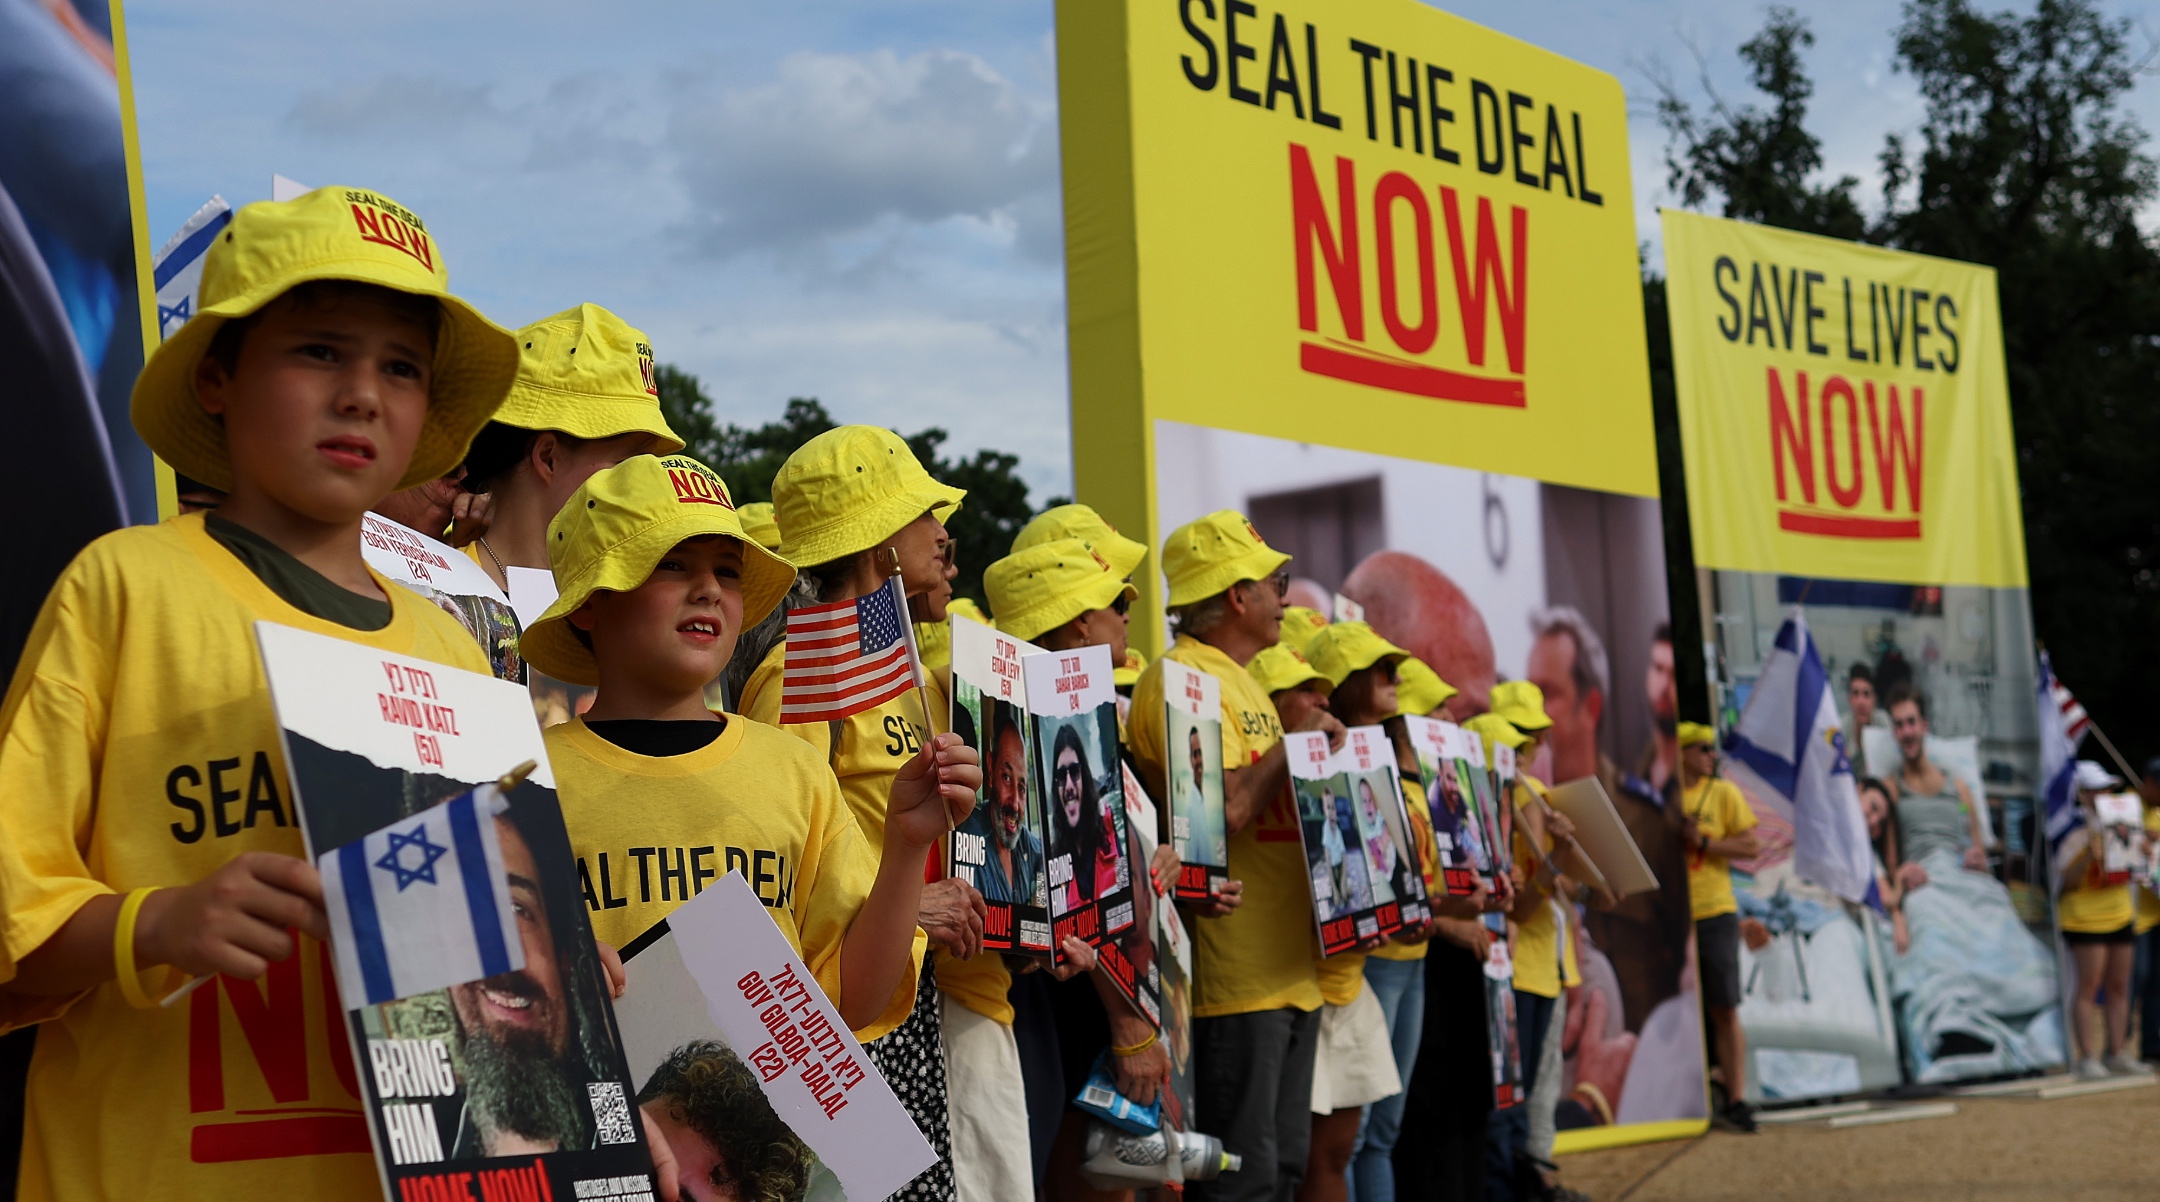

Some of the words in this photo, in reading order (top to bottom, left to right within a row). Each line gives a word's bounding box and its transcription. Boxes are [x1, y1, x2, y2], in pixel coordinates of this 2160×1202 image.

[1178, 0, 1342, 132] SEAL
[1349, 38, 1461, 166] THE
[1470, 78, 1605, 207] DEAL
[345, 190, 380, 208] SEAL
[377, 197, 401, 218] THE
[350, 203, 434, 273] NOW
[1289, 141, 1529, 376] NOW
[1713, 255, 1830, 357] SAVE
[1842, 276, 1961, 376] LIVES
[1766, 365, 1924, 515] NOW
[661, 459, 687, 469] SEAL
[667, 469, 734, 510] NOW
[361, 529, 392, 553] EDEN
[386, 536, 452, 572] YERUSHALMI
[405, 557, 433, 585] (24)
[992, 655, 1007, 677] EITAN
[1007, 660, 1020, 681] LEVY
[376, 691, 424, 729] RAVID
[421, 702, 461, 737] KATZ
[412, 731, 444, 770] (51)
[955, 831, 986, 867] BRING
[1048, 853, 1074, 888] BRING
[985, 904, 1012, 938] NOW!
[1050, 885, 1068, 918] HIM
[1076, 902, 1100, 939] NOW!
[769, 962, 846, 1063] גלבוע-דלאל
[737, 970, 775, 1008] GUY
[759, 1003, 849, 1121] GILBOA-DALAL
[748, 1041, 789, 1084] (22)
[366, 1038, 456, 1099] BRING
[830, 1054, 866, 1091] גיא
[382, 1103, 445, 1166] HIM
